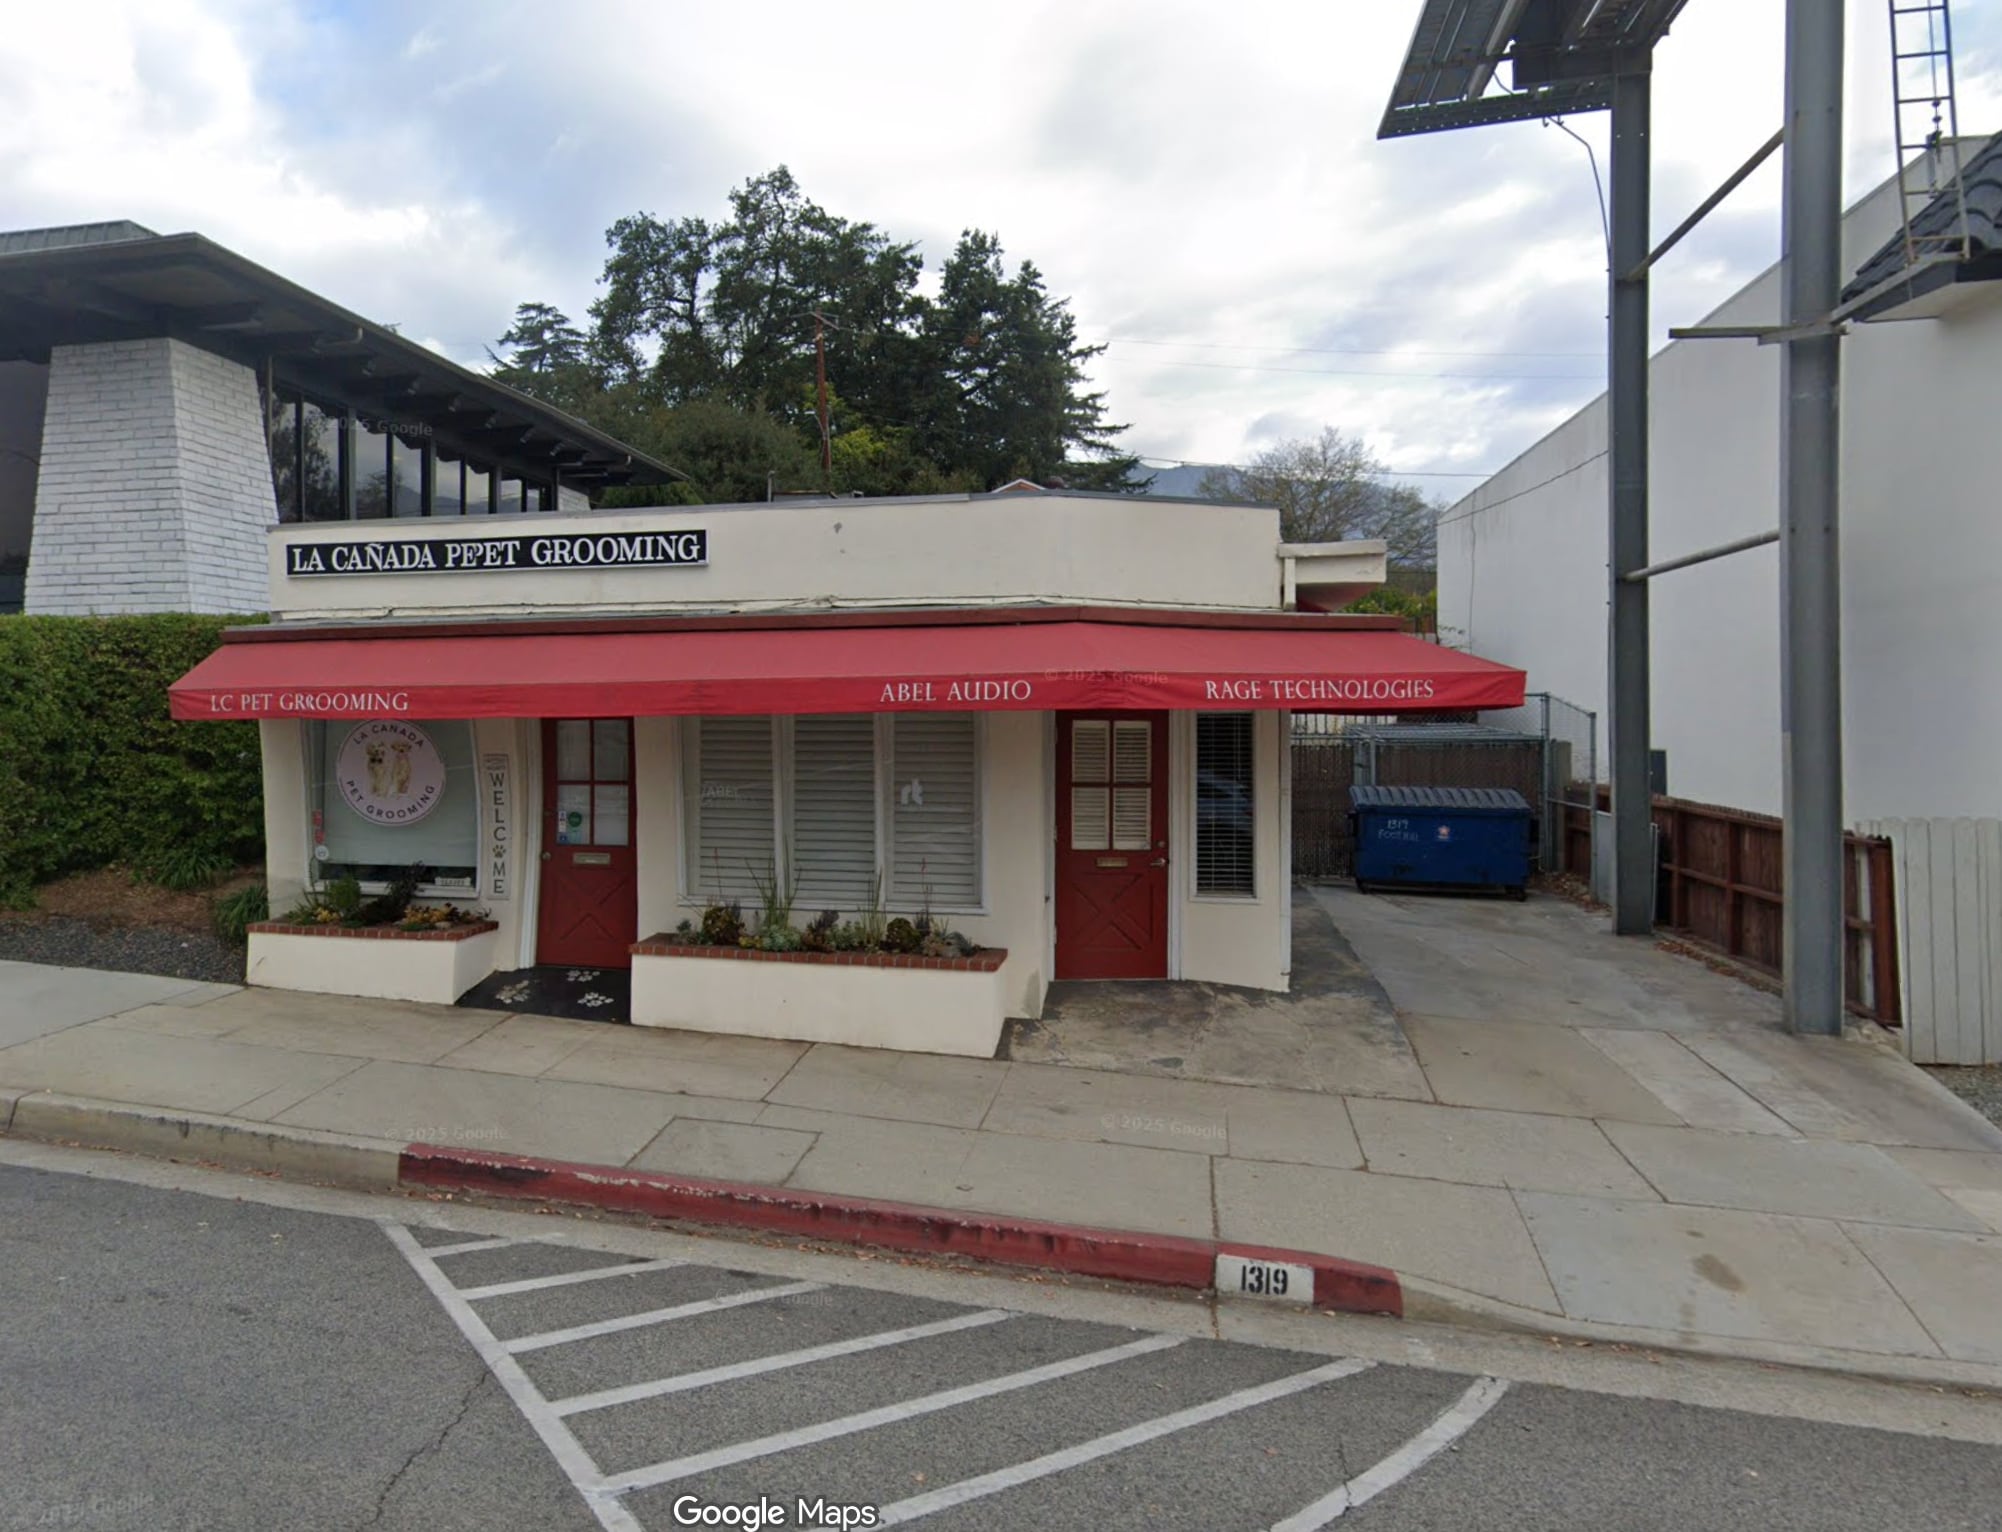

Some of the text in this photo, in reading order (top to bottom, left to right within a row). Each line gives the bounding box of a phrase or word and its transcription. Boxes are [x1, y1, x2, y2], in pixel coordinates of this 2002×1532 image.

[292, 548, 325, 572] LA
[331, 543, 437, 572] CAÑADA
[531, 534, 701, 565] GROOMING
[880, 680, 1031, 702] ABEL AUDIO
[1205, 679, 1434, 699] RAGE TECHNOLOGIES
[211, 694, 233, 712] LC
[241, 693, 273, 711] PET
[353, 731, 368, 745] LA
[346, 780, 435, 819] PET GROOMING
[489, 771, 507, 894] WELCME
[1241, 1265, 1288, 1295] 1319
